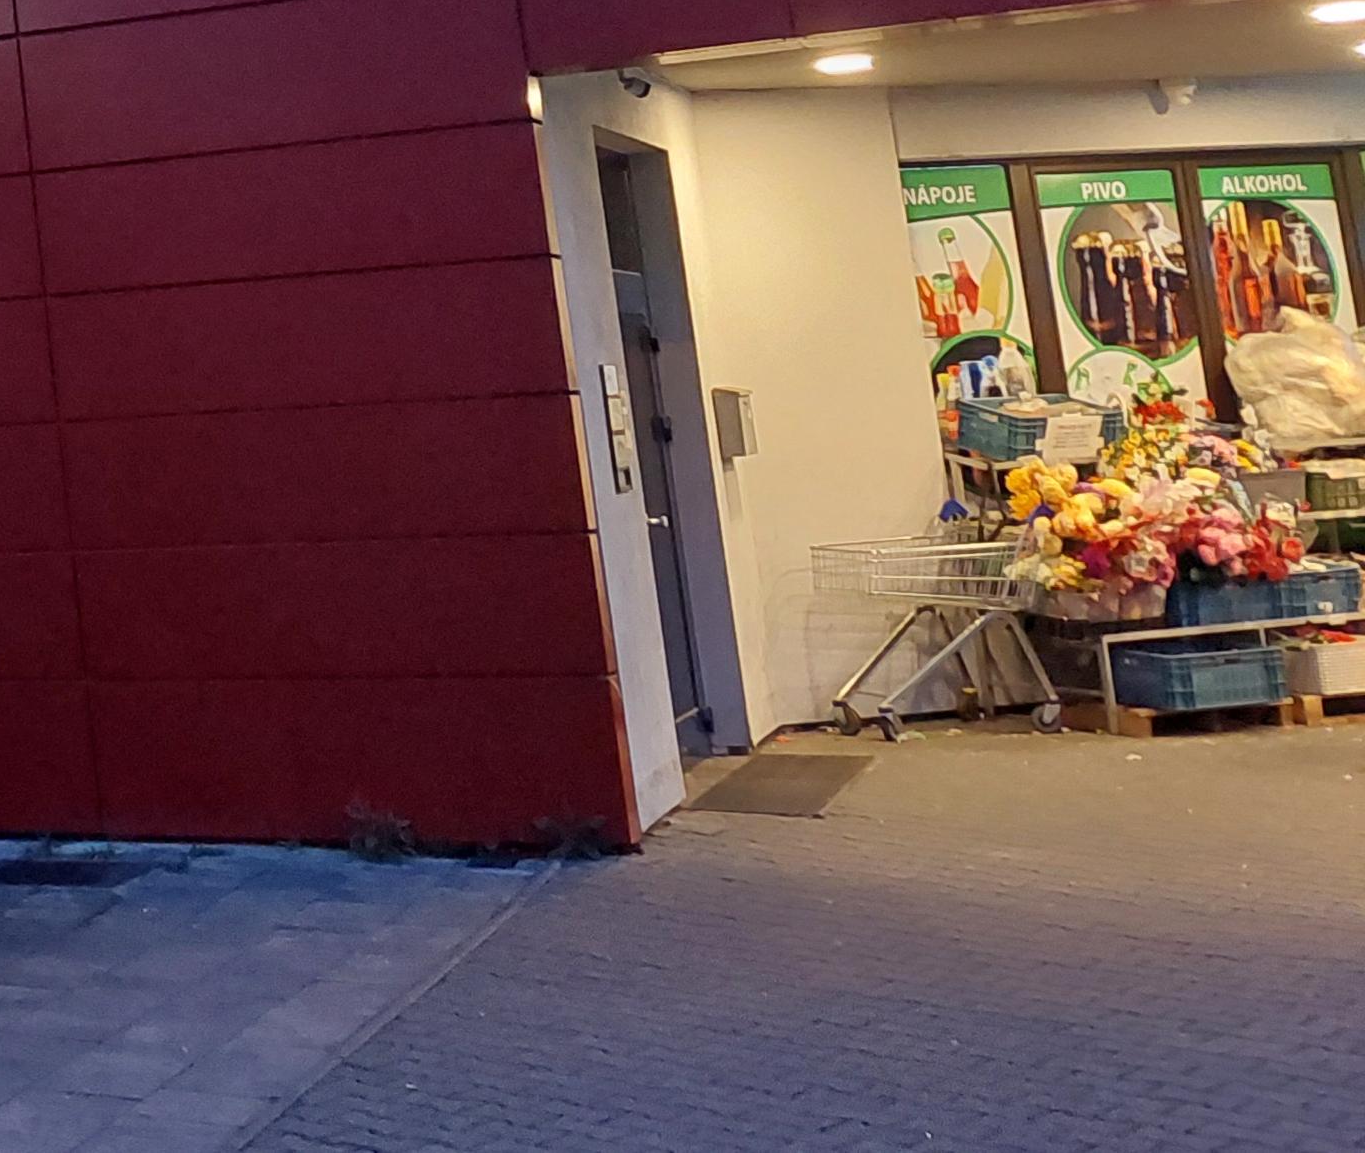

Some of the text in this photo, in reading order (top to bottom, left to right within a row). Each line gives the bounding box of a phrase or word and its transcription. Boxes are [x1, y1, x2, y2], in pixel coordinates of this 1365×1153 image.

[902, 184, 976, 205] NÁPOJE
[1080, 180, 1126, 201] PIVO
[1221, 173, 1308, 195] ALKOHOL
